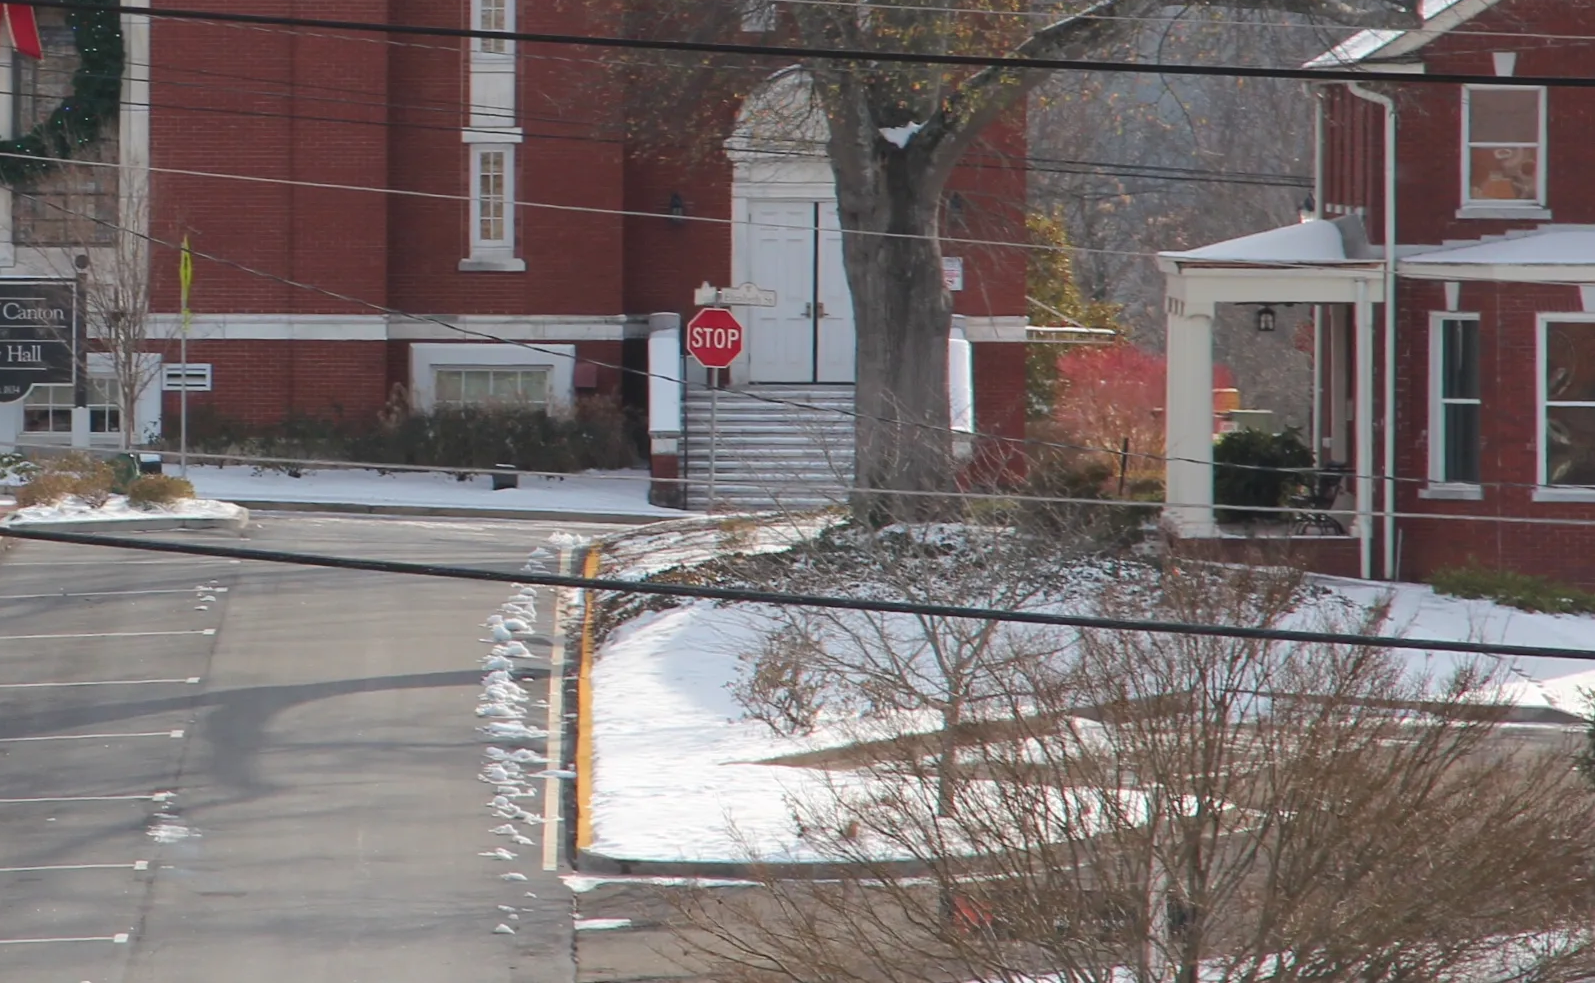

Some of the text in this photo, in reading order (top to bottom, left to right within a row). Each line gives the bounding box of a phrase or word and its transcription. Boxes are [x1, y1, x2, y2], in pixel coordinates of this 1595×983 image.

[3, 302, 65, 320] Canton
[691, 327, 739, 349] STOP
[6, 344, 42, 362] Hall
